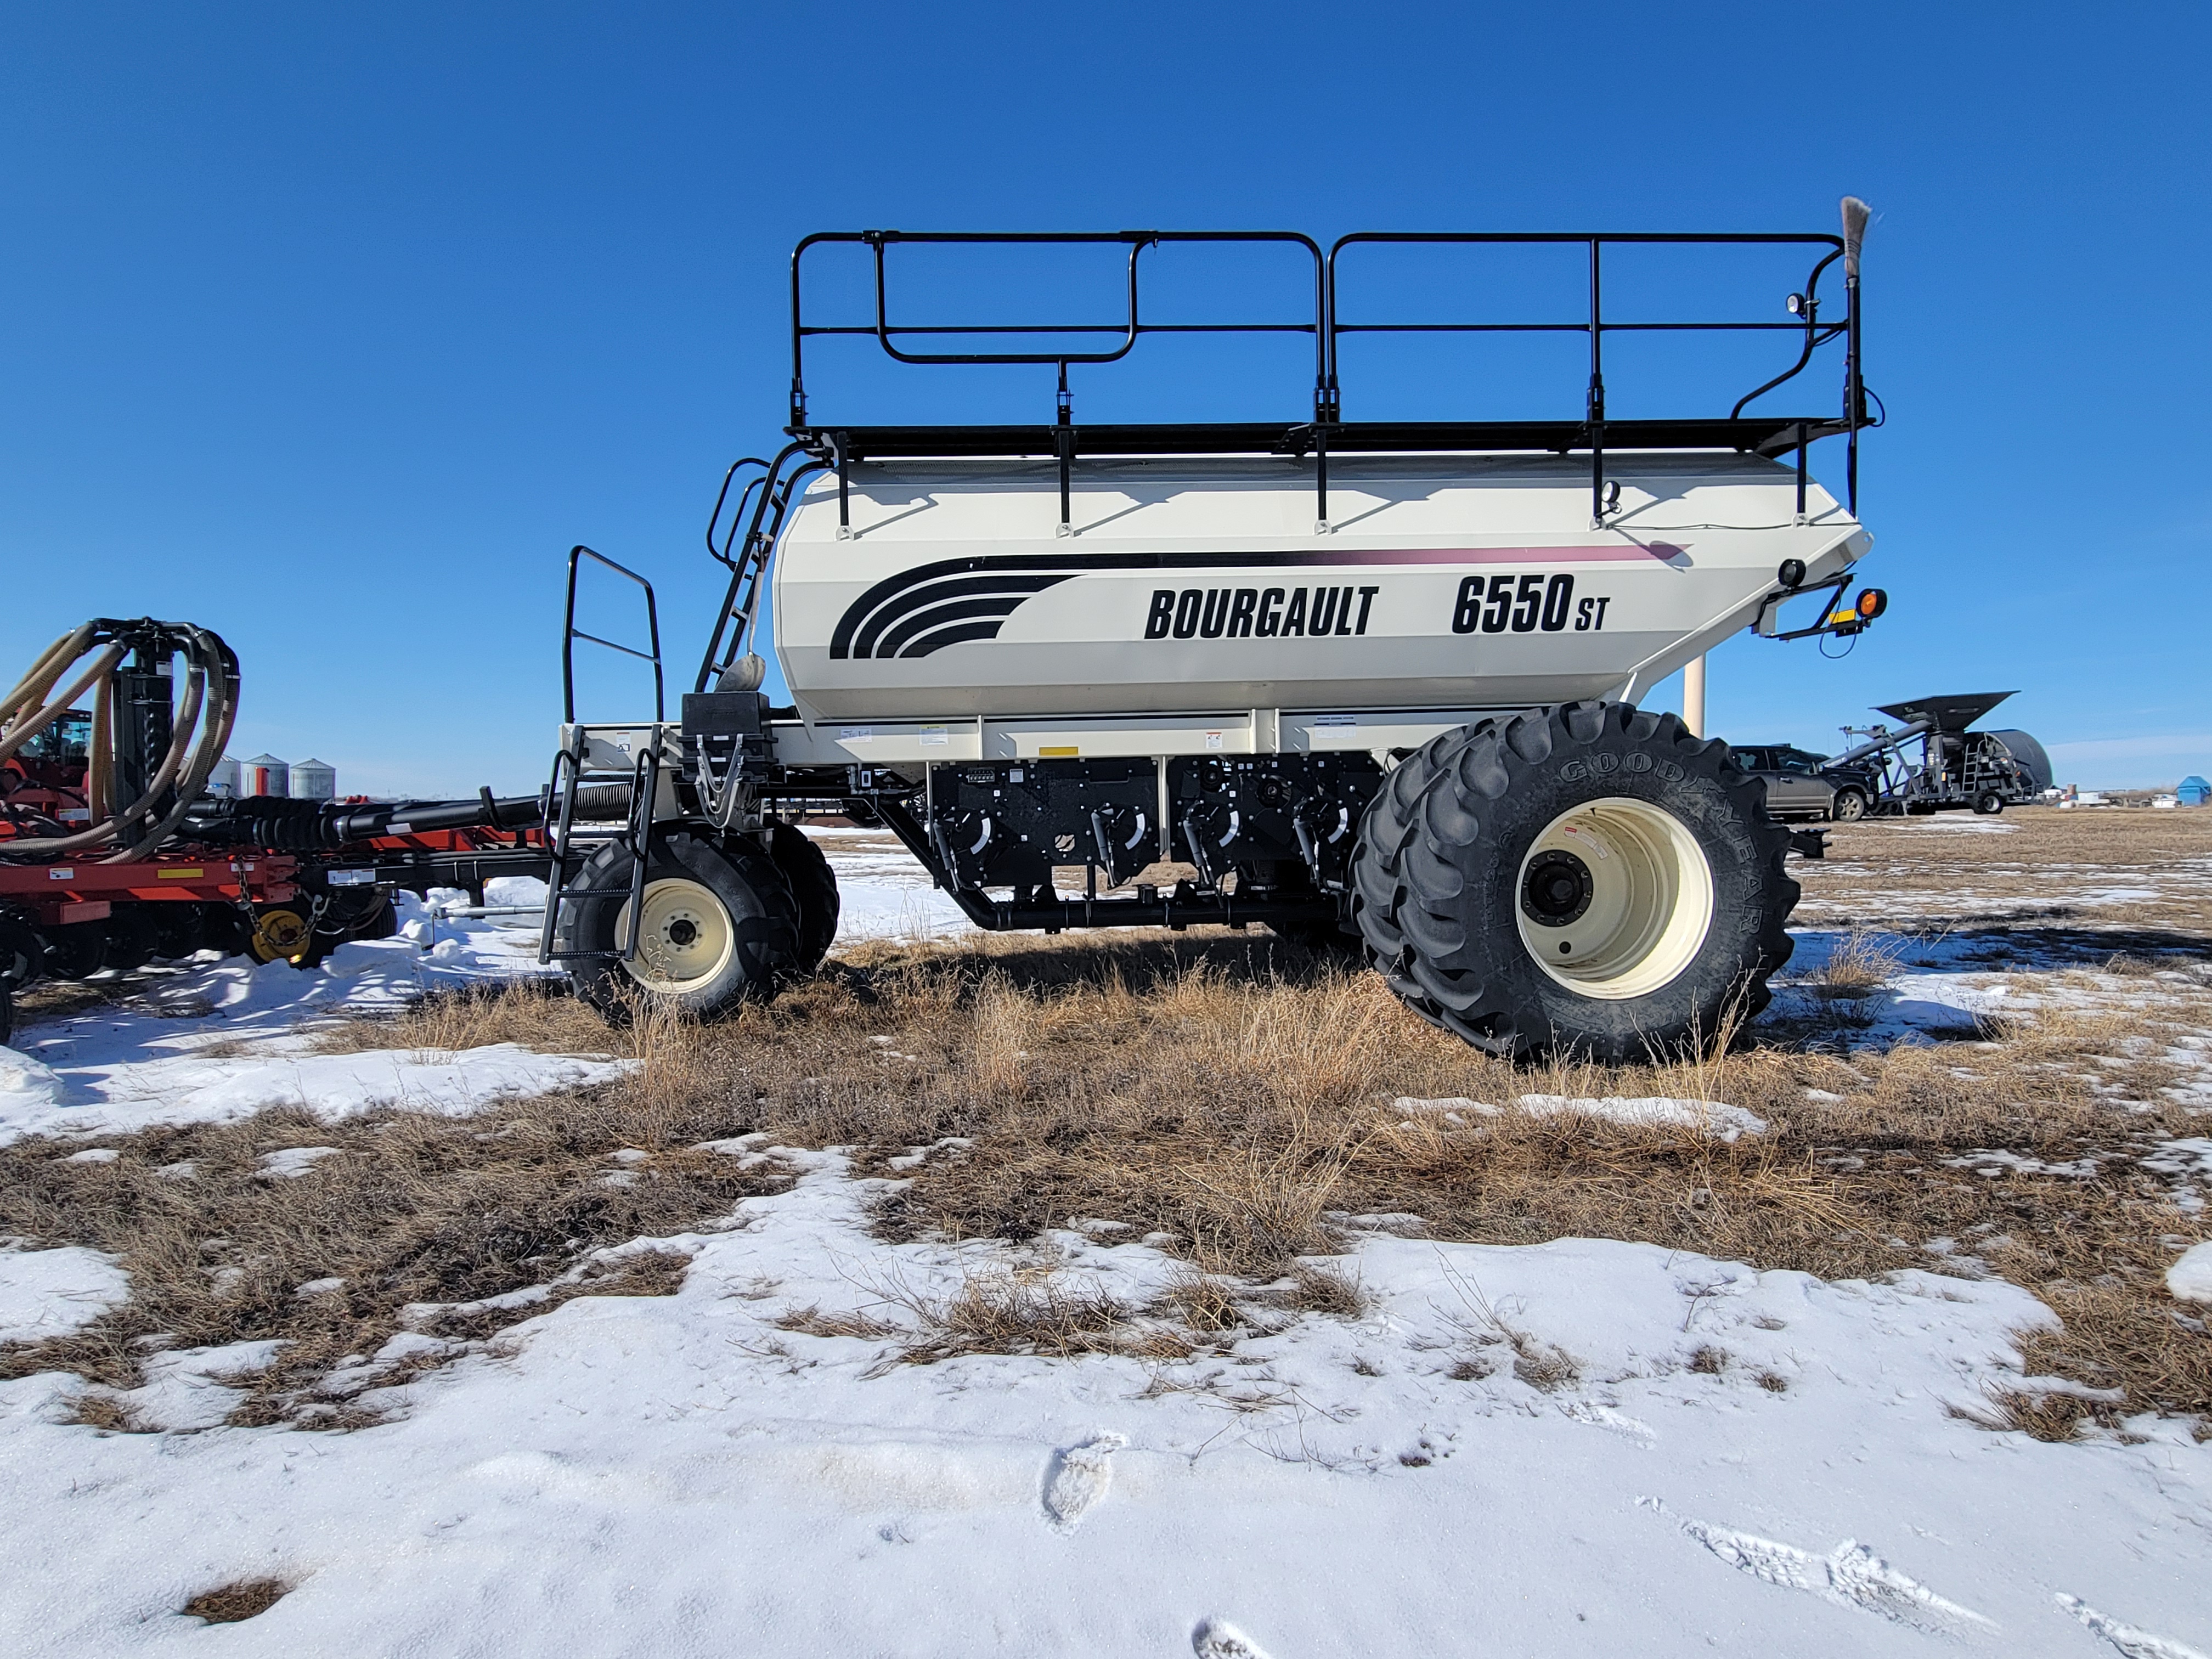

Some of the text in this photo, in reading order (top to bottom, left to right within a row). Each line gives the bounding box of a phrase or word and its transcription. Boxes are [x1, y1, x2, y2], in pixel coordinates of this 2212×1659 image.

[1144, 574, 1611, 639] BOURGAULT 6550 ST
[1559, 752, 1763, 934] GOODYEAR
